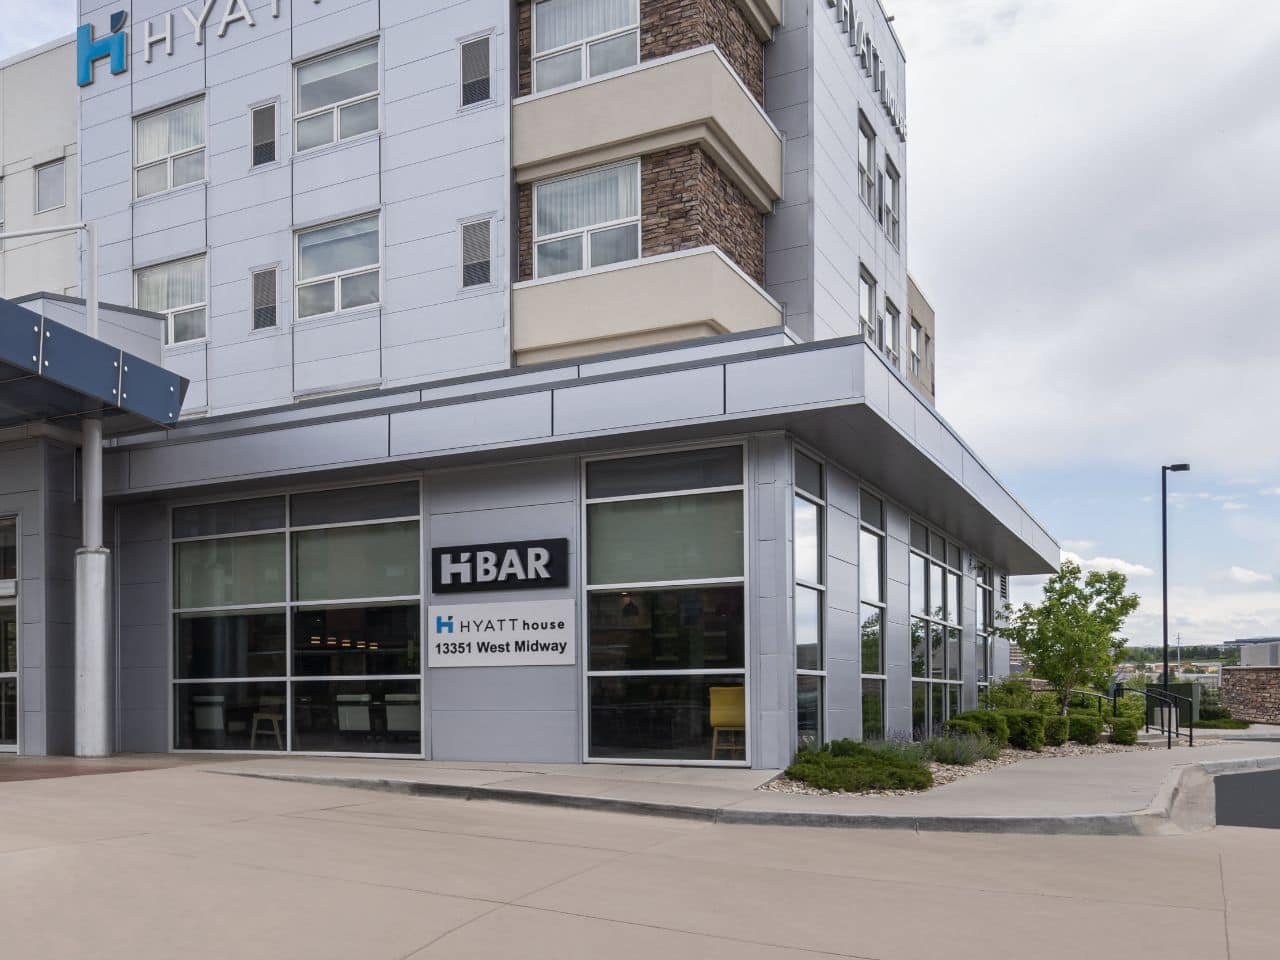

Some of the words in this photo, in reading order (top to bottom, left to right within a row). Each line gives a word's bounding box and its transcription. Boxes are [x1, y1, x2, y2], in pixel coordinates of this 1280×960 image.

[460, 618, 518, 633] HYATT
[522, 619, 566, 631] house
[435, 642, 472, 654] 13351
[476, 641, 511, 653] West
[514, 640, 568, 654] Midway
